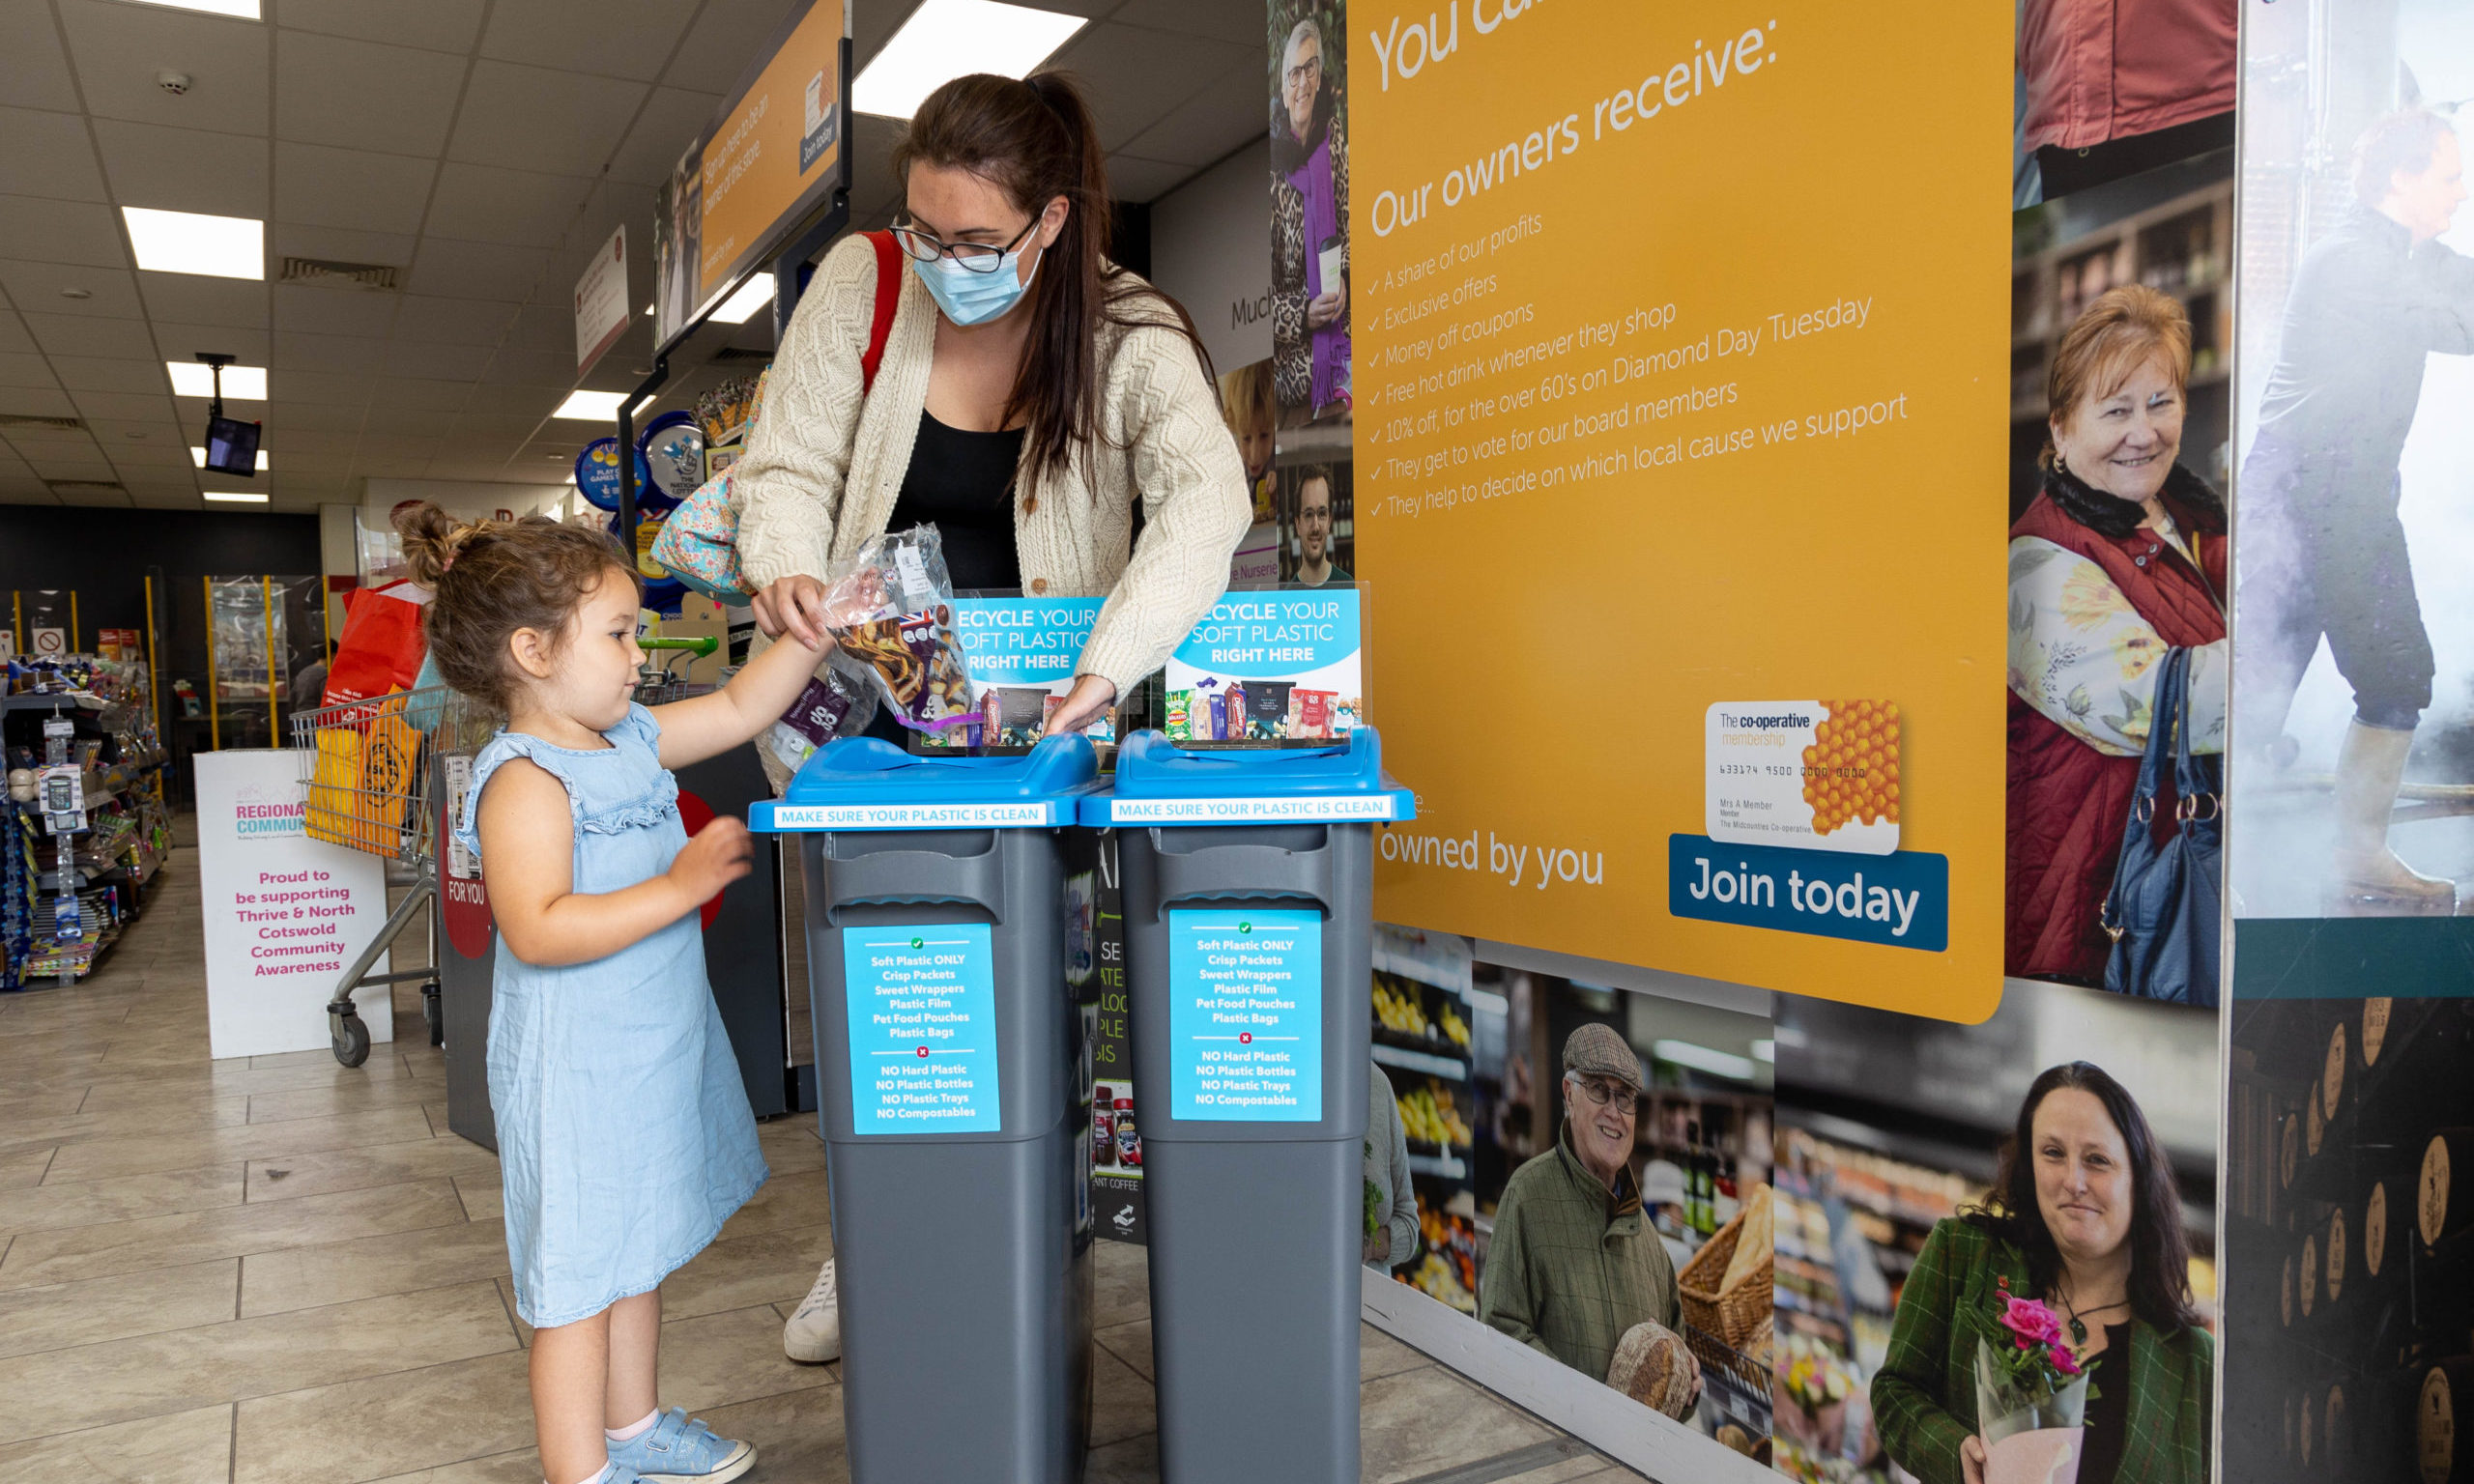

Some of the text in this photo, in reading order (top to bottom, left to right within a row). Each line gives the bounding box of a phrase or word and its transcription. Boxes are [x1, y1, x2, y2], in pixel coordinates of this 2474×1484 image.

[1369, 0, 1458, 93] You
[1371, 19, 1777, 238] Our owners receive:
[1384, 214, 1542, 292] A share of our profits
[1385, 274, 1498, 330] Exclusive offers
[1385, 303, 1535, 368] Money off coupons
[1386, 302, 1677, 405] Free hot drink whenever they shop
[1386, 296, 1873, 442] 10% off, for the over 60's on Diamond Day Tuesday
[1386, 382, 1739, 480] They get to vote for our board members
[1387, 391, 1909, 519] They help to decide on which local cause we support
[958, 609, 1096, 627] ECYCLE YOUR
[1281, 602, 1339, 619] YOUR
[962, 631, 1088, 650] OFT PLASTIC
[1192, 624, 1334, 643] SOFT PLASTIC
[969, 654, 1070, 670] RIGHT HERE
[1211, 647, 1314, 663] RIGHT HERE
[1720, 712, 1810, 730] The co-operative
[1722, 731, 1786, 749] membership
[1766, 765, 1792, 776] 9500
[1800, 766, 1827, 777] 0000
[1836, 767, 1865, 779] 0000
[236, 804, 304, 819] REGIONA
[1118, 800, 1383, 816] MAKE SURE YOUR PLASTIC IS CLEAN
[1720, 798, 1772, 810] Mrs A Member
[781, 808, 1039, 823] MAKE SURE YOUR PLASTIC IS CLEAN
[1720, 819, 1812, 834] The Midcounties Co-operative
[1380, 830, 1603, 890] owned by you
[259, 870, 330, 884] Proud to
[236, 887, 350, 904] be supporting
[448, 881, 484, 905] FOR YOU
[1689, 857, 1920, 937] Join today
[236, 904, 355, 923] Thrive & North
[258, 923, 335, 939] Cotswold
[251, 941, 345, 958] Community
[1196, 940, 1294, 951] Soft Plastic ONLY
[871, 955, 965, 966] Soft Plastic ONLY
[1208, 955, 1283, 967] Crisp Packets
[255, 960, 340, 977] Awareness
[882, 969, 956, 983] Crisp Packets
[1199, 969, 1291, 982] Sweet Wrappers
[875, 985, 964, 997] Sweet Wrappers
[1214, 984, 1277, 994] Plastic Film
[889, 998, 951, 1010] Plastic Film
[1196, 998, 1295, 1009] Pet Food Pouches
[874, 1013, 969, 1024] Pet Food Pouches
[1212, 1013, 1279, 1025] Plastic Bags
[889, 1027, 954, 1039] Plastic Bags
[1201, 1051, 1290, 1062] NO Hard Plastic
[880, 1065, 966, 1075] NO Hard Plastic
[1195, 1066, 1296, 1076] NO Plastic Bottles
[876, 1078, 973, 1090] NO Plastic Bottles
[1201, 1080, 1290, 1093] NO Plastic Trays
[881, 1093, 969, 1104] NO Plastic Trays
[1195, 1095, 1297, 1107] NO Compostables
[877, 1107, 976, 1120] NO Compostables
[1109, 1179, 1138, 1191] COFFEE
